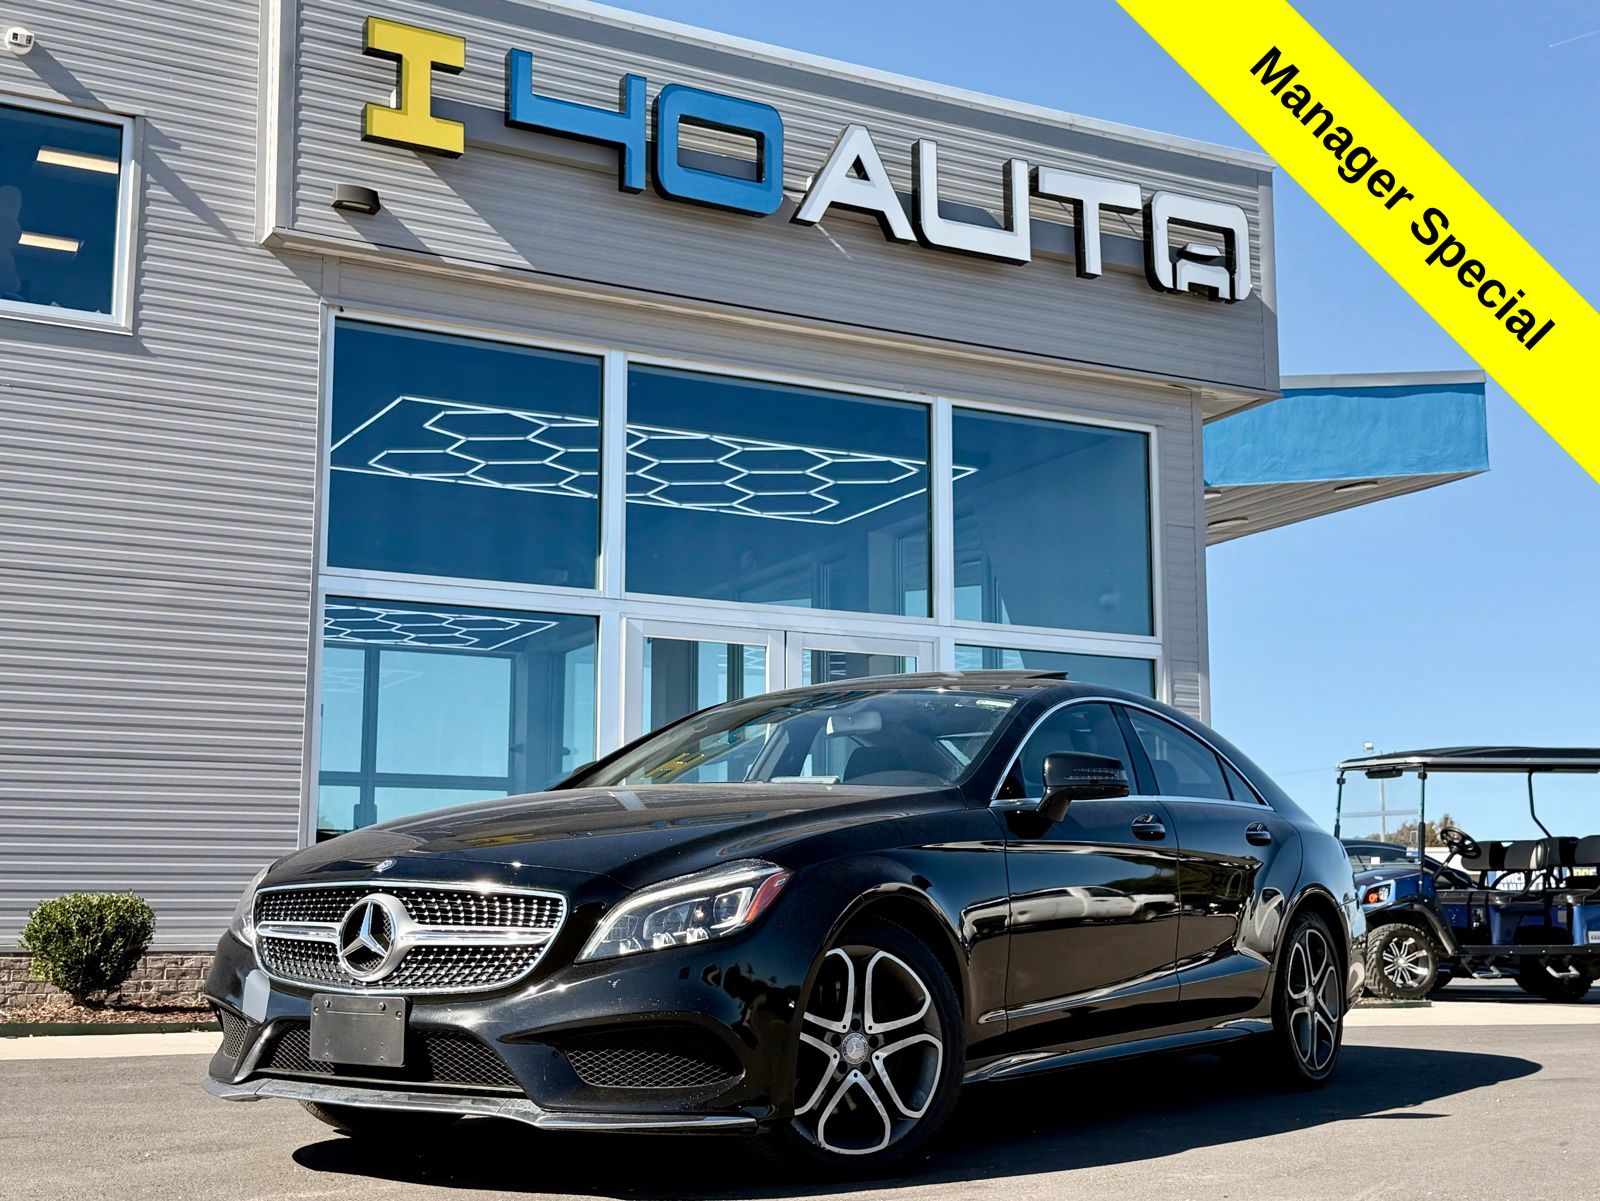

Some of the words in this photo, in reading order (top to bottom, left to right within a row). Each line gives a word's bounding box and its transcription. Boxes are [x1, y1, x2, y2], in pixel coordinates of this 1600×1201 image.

[362, 15, 466, 159] I
[504, 47, 784, 218] 40
[789, 122, 1253, 304] AUTO
